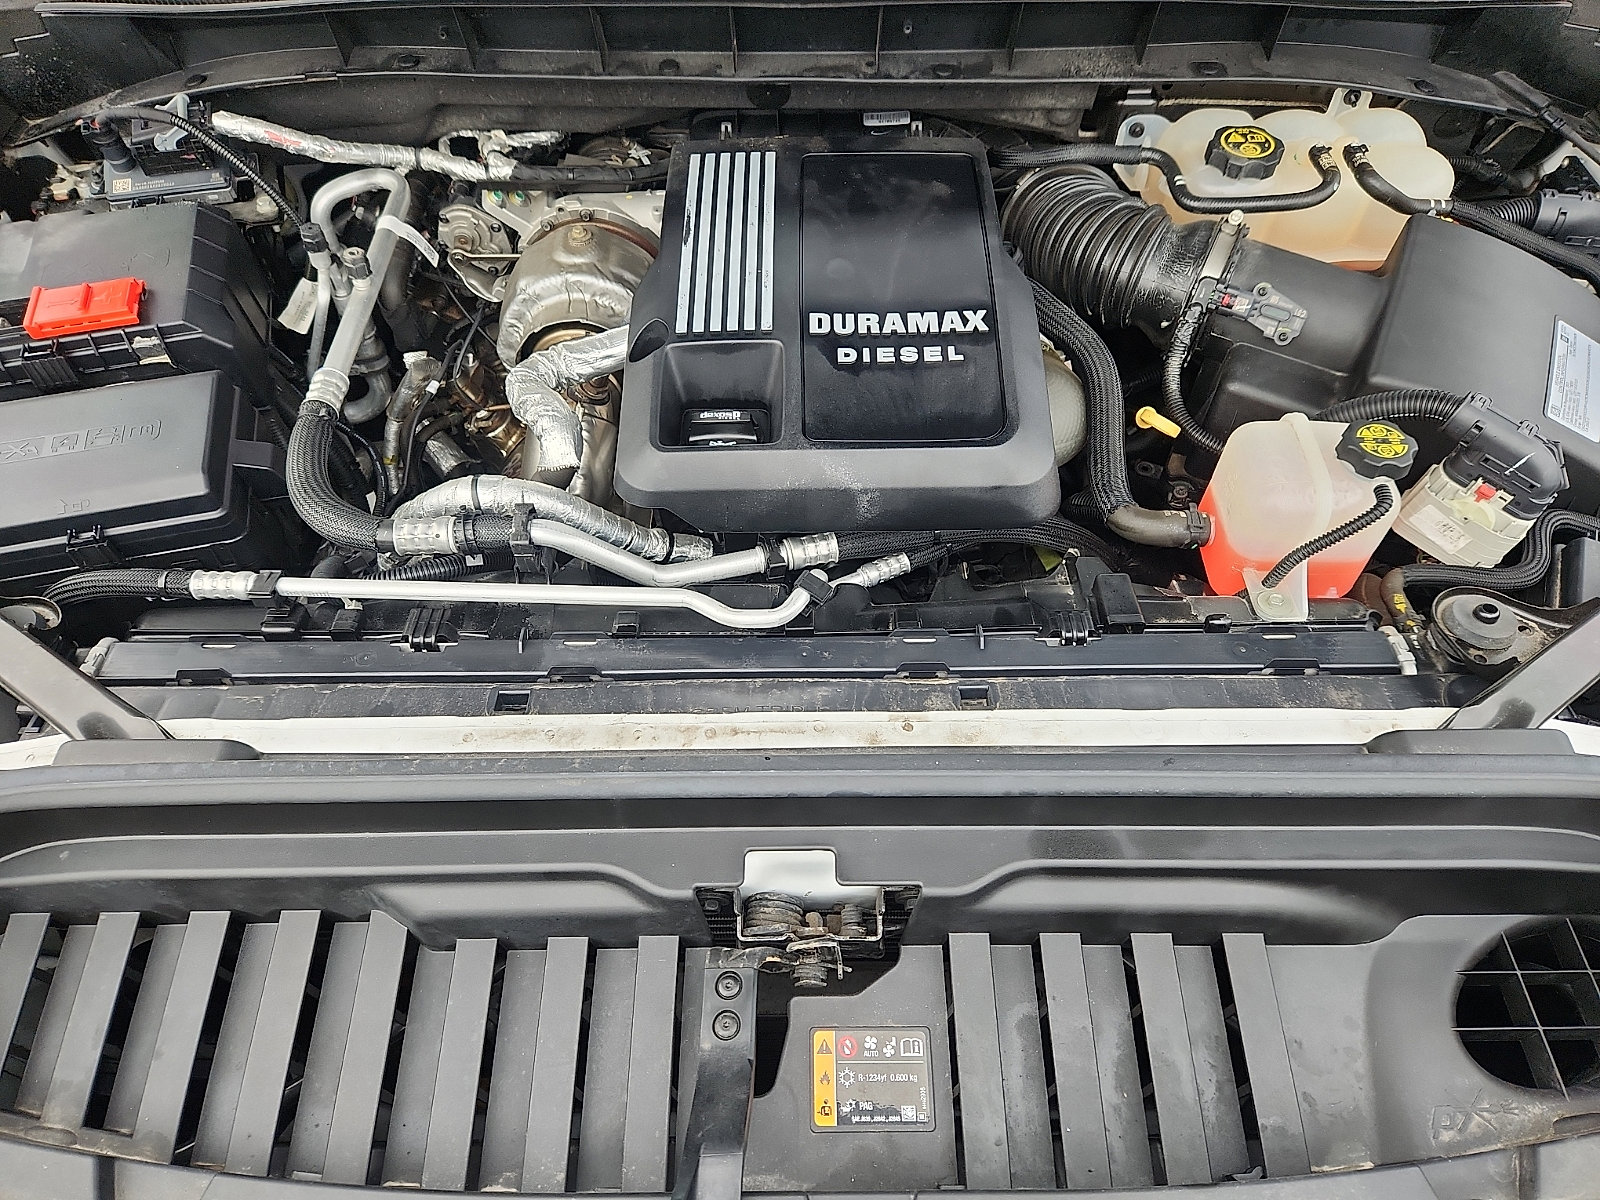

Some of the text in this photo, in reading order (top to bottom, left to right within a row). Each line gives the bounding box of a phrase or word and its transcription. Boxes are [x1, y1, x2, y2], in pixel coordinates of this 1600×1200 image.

[808, 309, 989, 335] DURAMAX
[837, 345, 965, 364] DIESEL
[863, 1050, 879, 1058] AUTO
[858, 1073, 918, 1083] R-1234yf 0.600 kg
[859, 1101, 874, 1111] PAG
